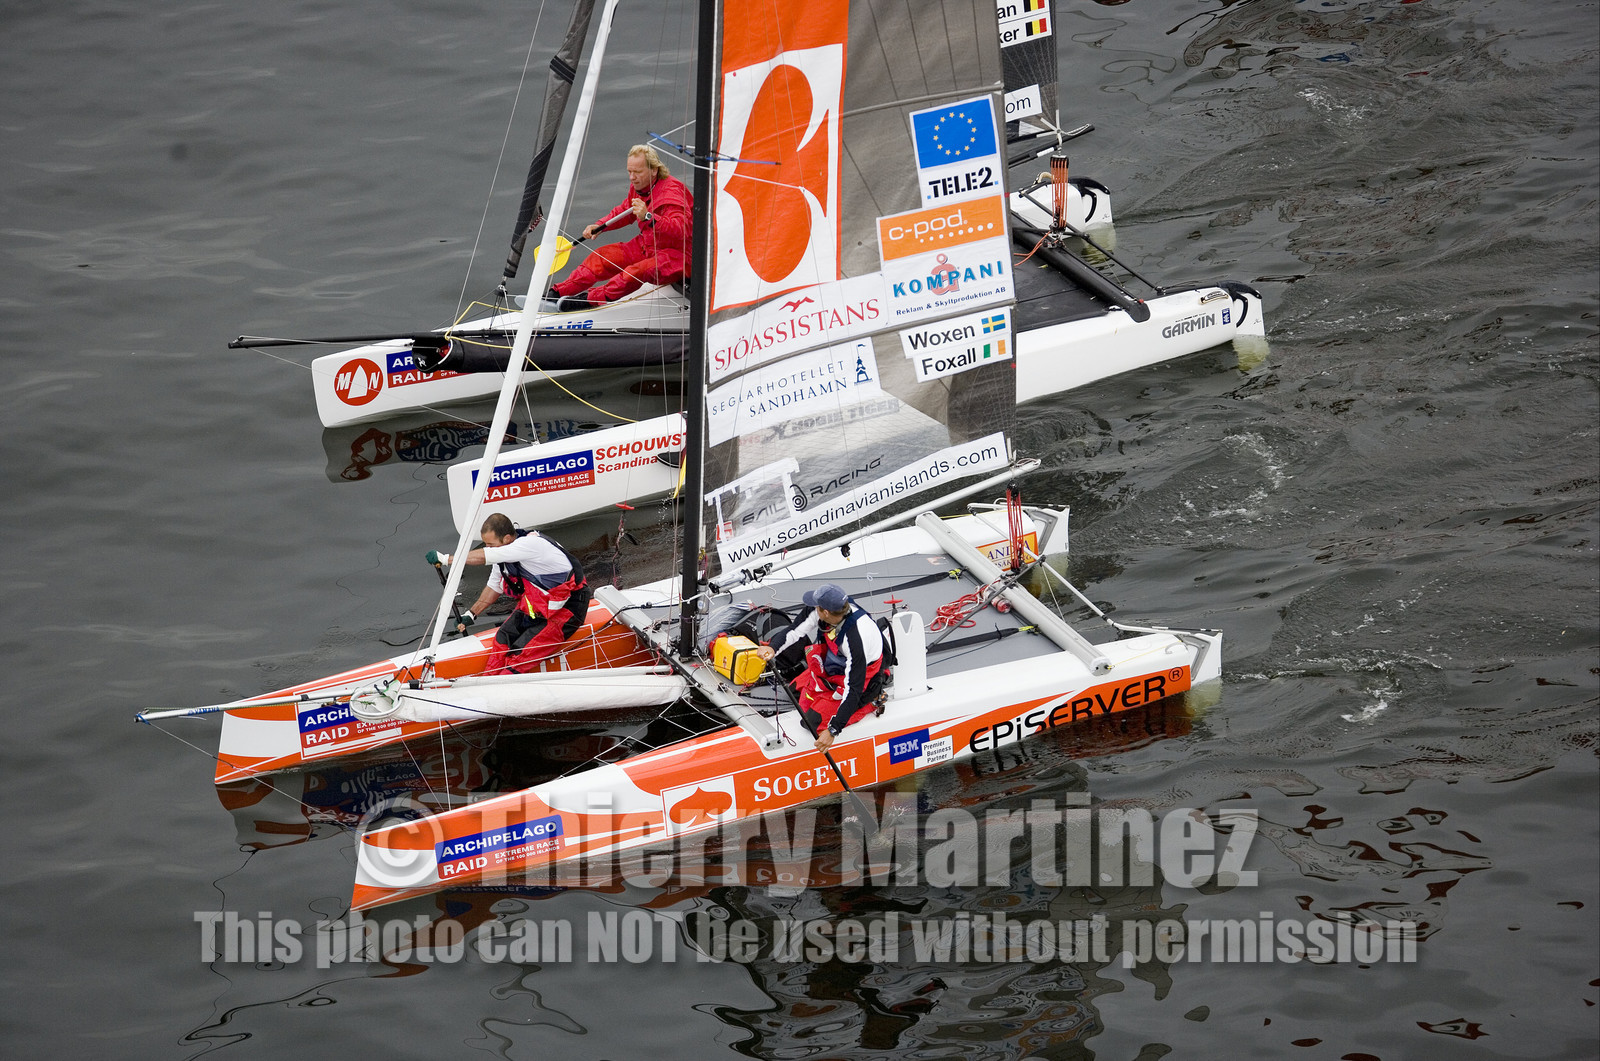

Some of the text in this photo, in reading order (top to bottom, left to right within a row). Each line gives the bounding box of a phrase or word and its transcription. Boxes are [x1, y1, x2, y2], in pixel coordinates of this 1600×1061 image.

[893, 260, 1003, 298] KOMPANI
[896, 306, 924, 315] Reklam
[935, 290, 992, 306] Skyltproduktion
[714, 298, 880, 371] SJÖASSISTANS
[908, 324, 975, 350] Woxen
[1162, 314, 1215, 339] GARMIN
[921, 347, 977, 375] Foxall
[393, 371, 433, 384] RAID
[712, 360, 845, 416] SEGLARHOTELLET
[749, 377, 848, 418] SANDHAMN
[491, 457, 588, 482] RCHIPELAGO
[528, 473, 589, 488] EXTREME RACE
[728, 445, 998, 563] www.scandinavianislands.com
[742, 457, 882, 526] SAIL RACING
[305, 726, 350, 745] RAID
[893, 739, 919, 756] IBM
[924, 741, 945, 750] Premier
[927, 746, 951, 756] Business
[927, 754, 947, 763] Partner
[753, 757, 859, 802] SOGETI
[442, 822, 557, 857] ARCHIPELAGO
[495, 839, 559, 859] EXTREME RACE
[537, 846, 560, 855] ISLANDS
[443, 857, 488, 876] RAID
